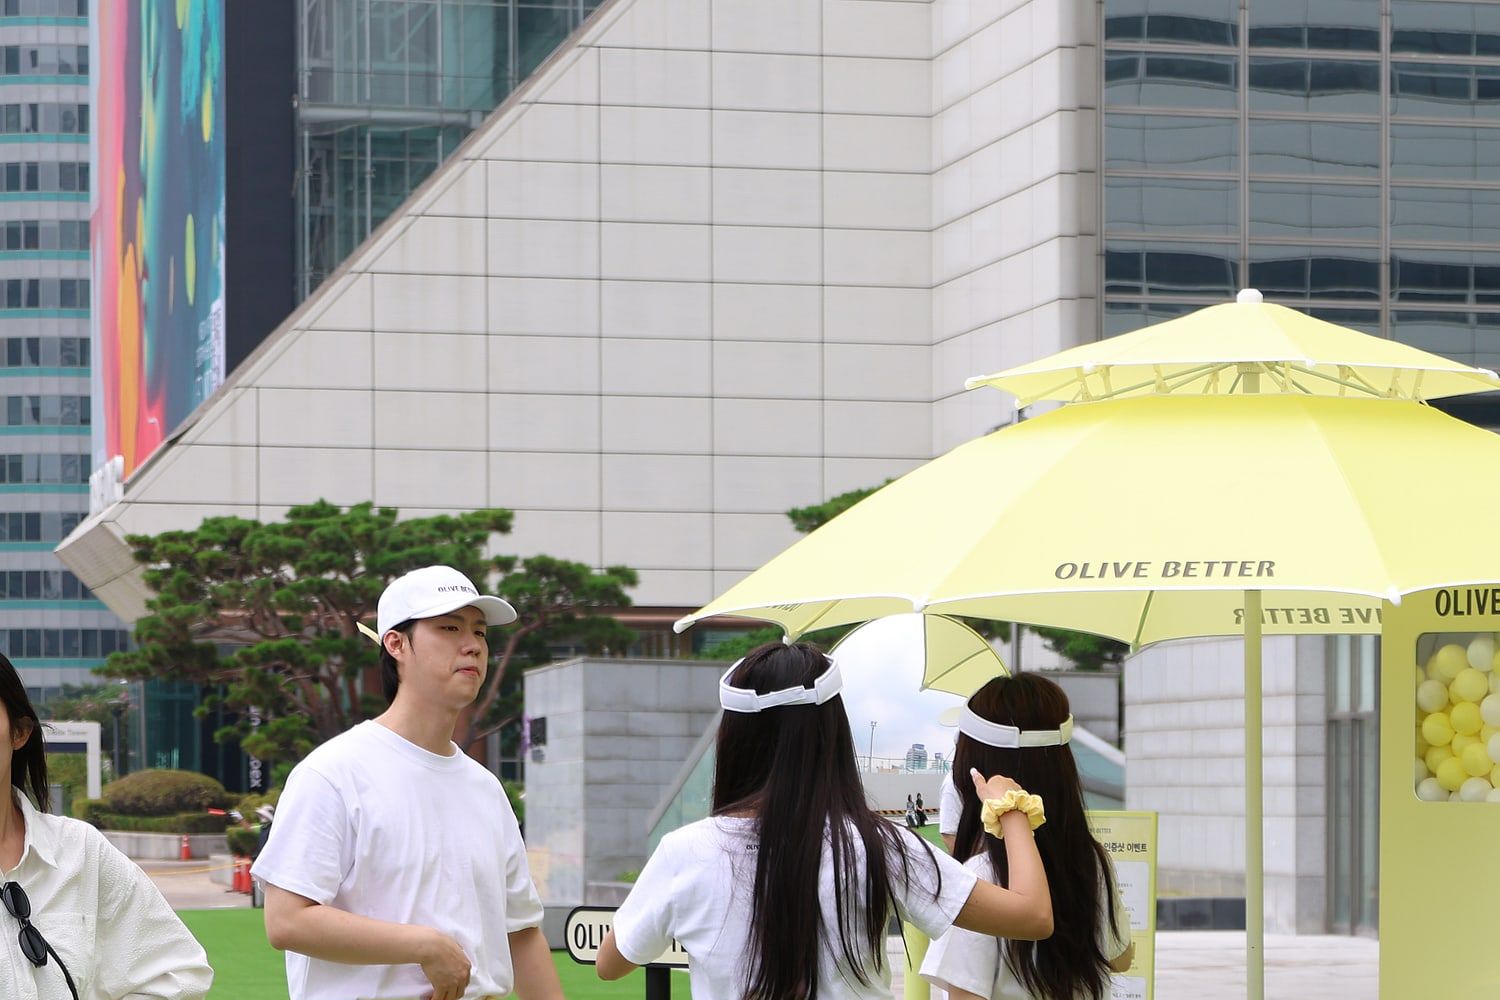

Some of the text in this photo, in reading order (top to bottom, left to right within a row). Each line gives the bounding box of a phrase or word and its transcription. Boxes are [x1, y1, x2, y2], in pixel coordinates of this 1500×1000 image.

[1054, 560, 1276, 580] OLIVE BETTER
[1126, 842, 1148, 853] 이벤트
